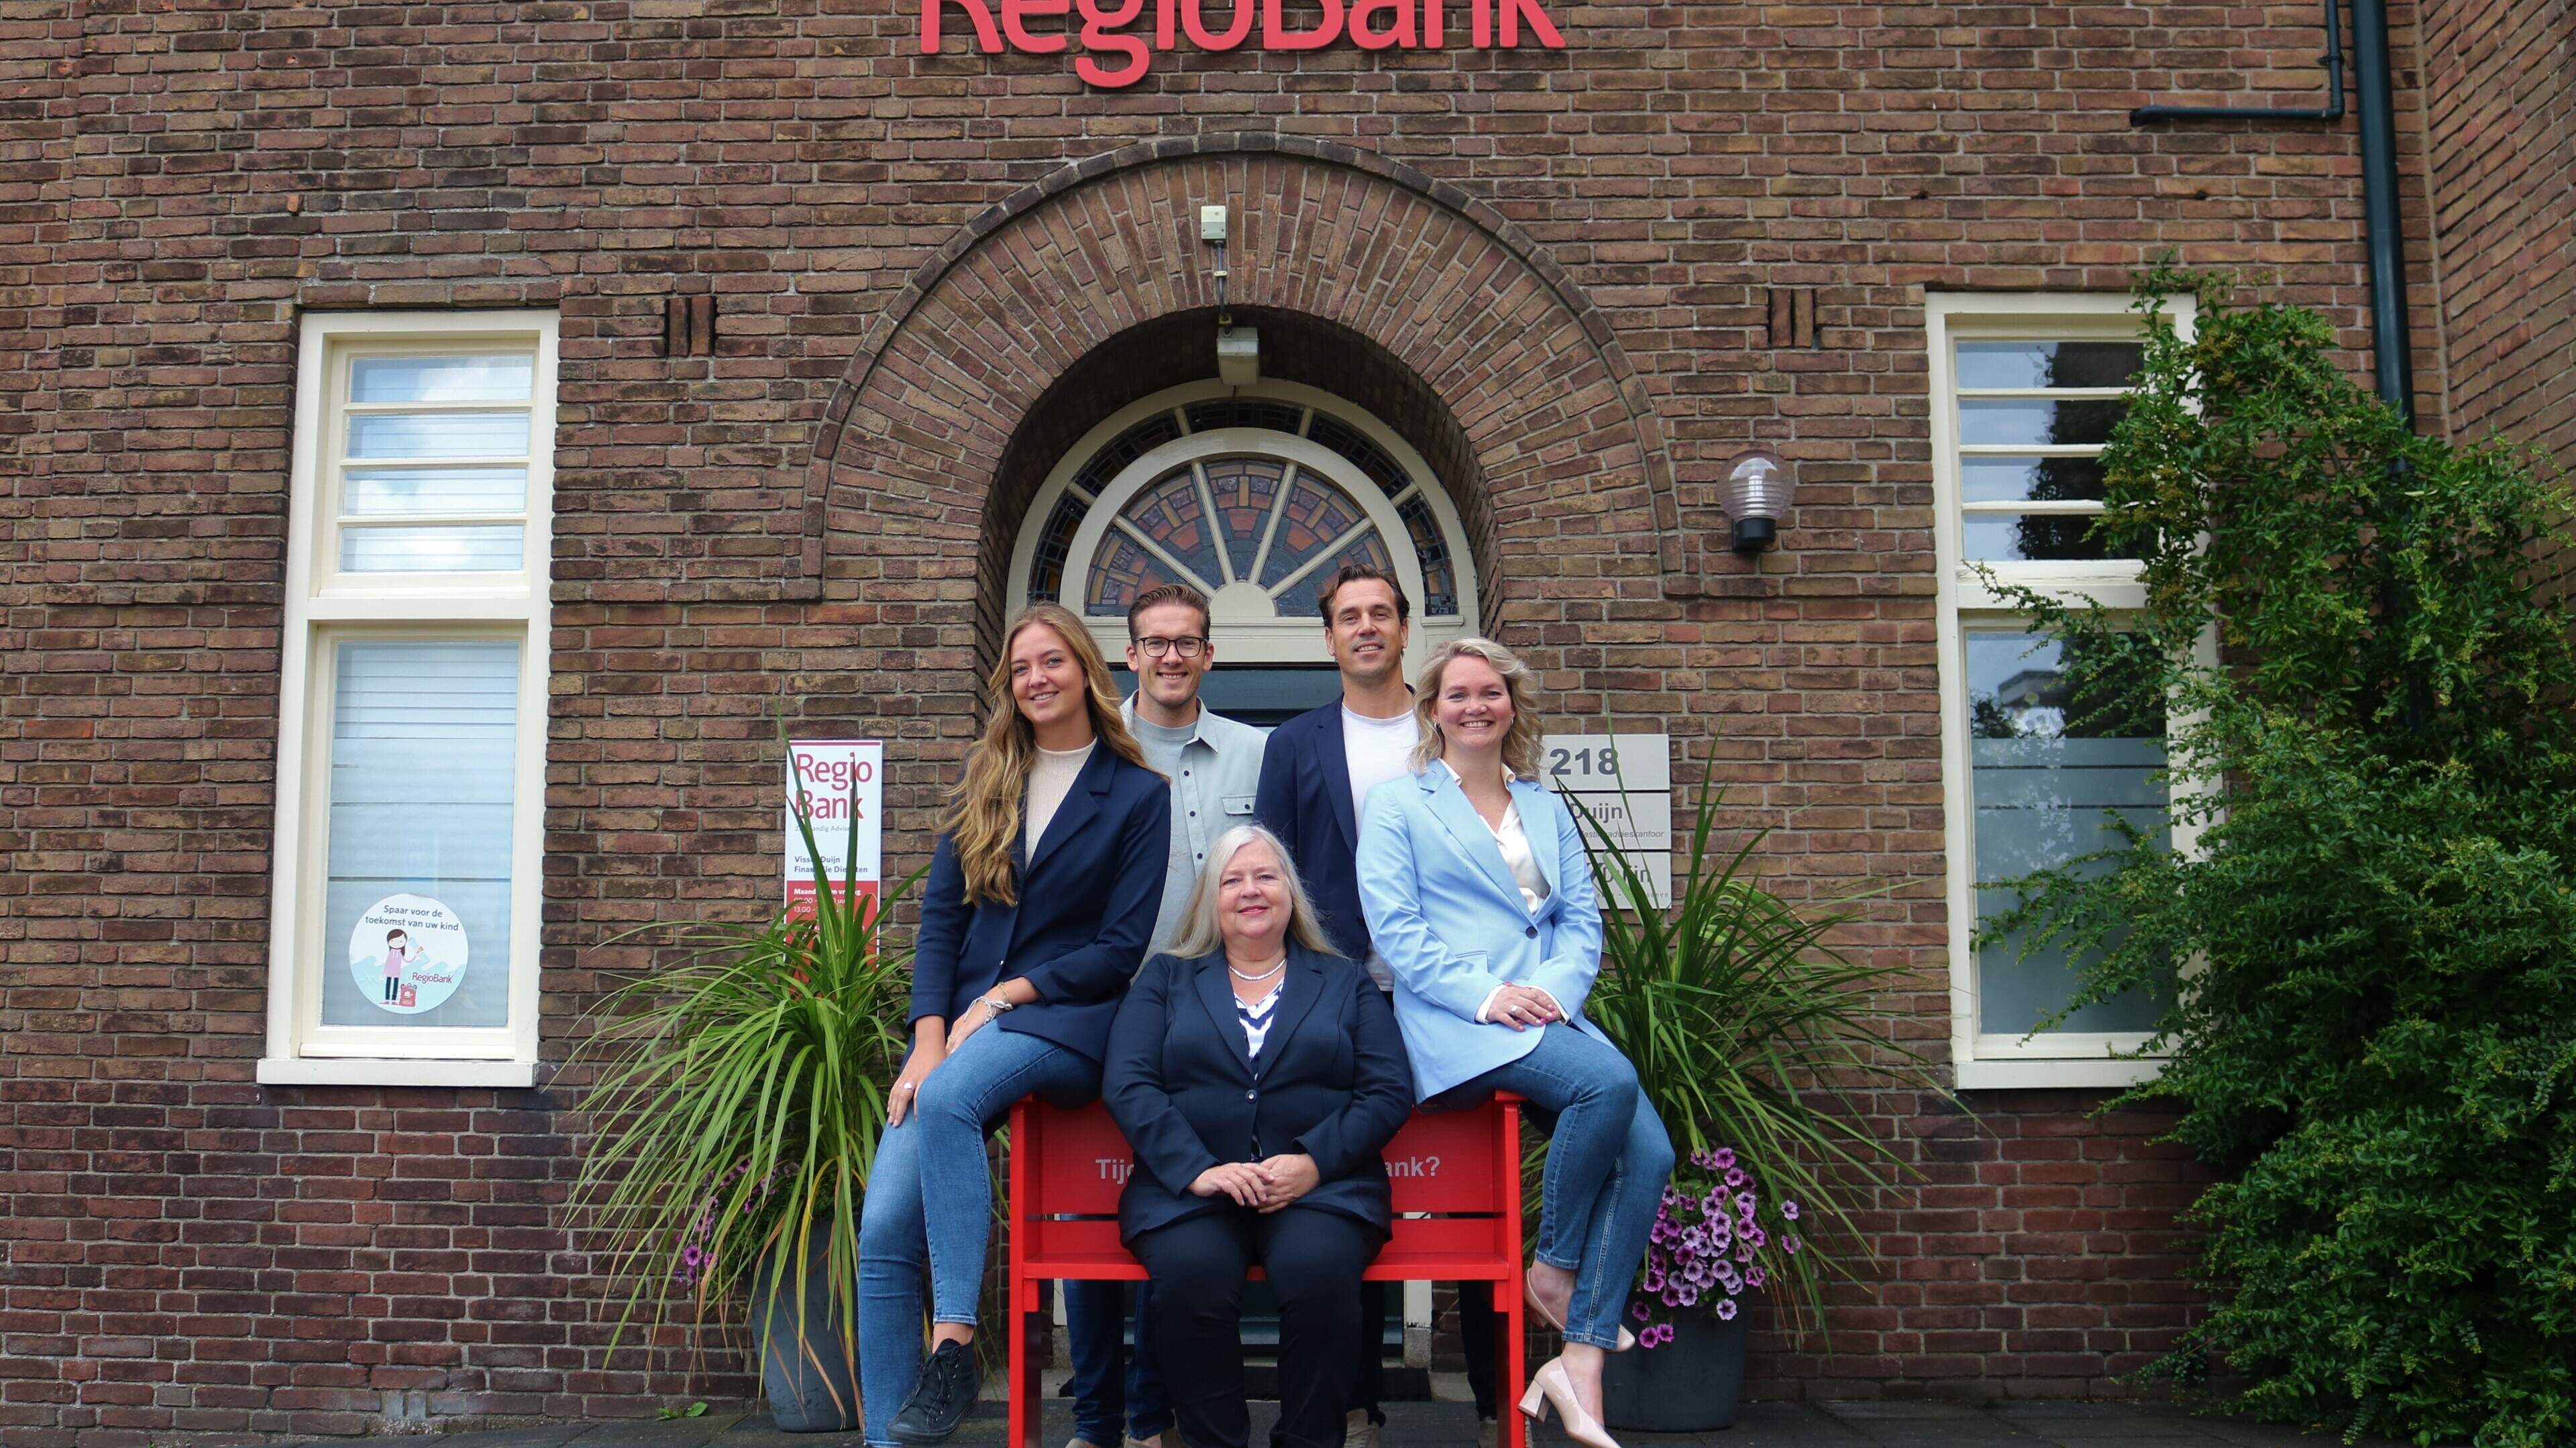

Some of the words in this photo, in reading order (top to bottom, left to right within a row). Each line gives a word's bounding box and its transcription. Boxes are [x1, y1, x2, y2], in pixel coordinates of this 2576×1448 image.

[1550, 748, 1619, 775] 218
[796, 752, 872, 791] Regio
[796, 789, 864, 819] Bank
[820, 856, 841, 864] Duijn
[383, 905, 409, 915] Spaar
[432, 909, 443, 917] de
[365, 916, 406, 926] toekomst
[408, 920, 423, 928] van
[440, 922, 459, 931] kind
[412, 972, 452, 984] RegioBank
[1385, 1156, 1440, 1177] ank?
